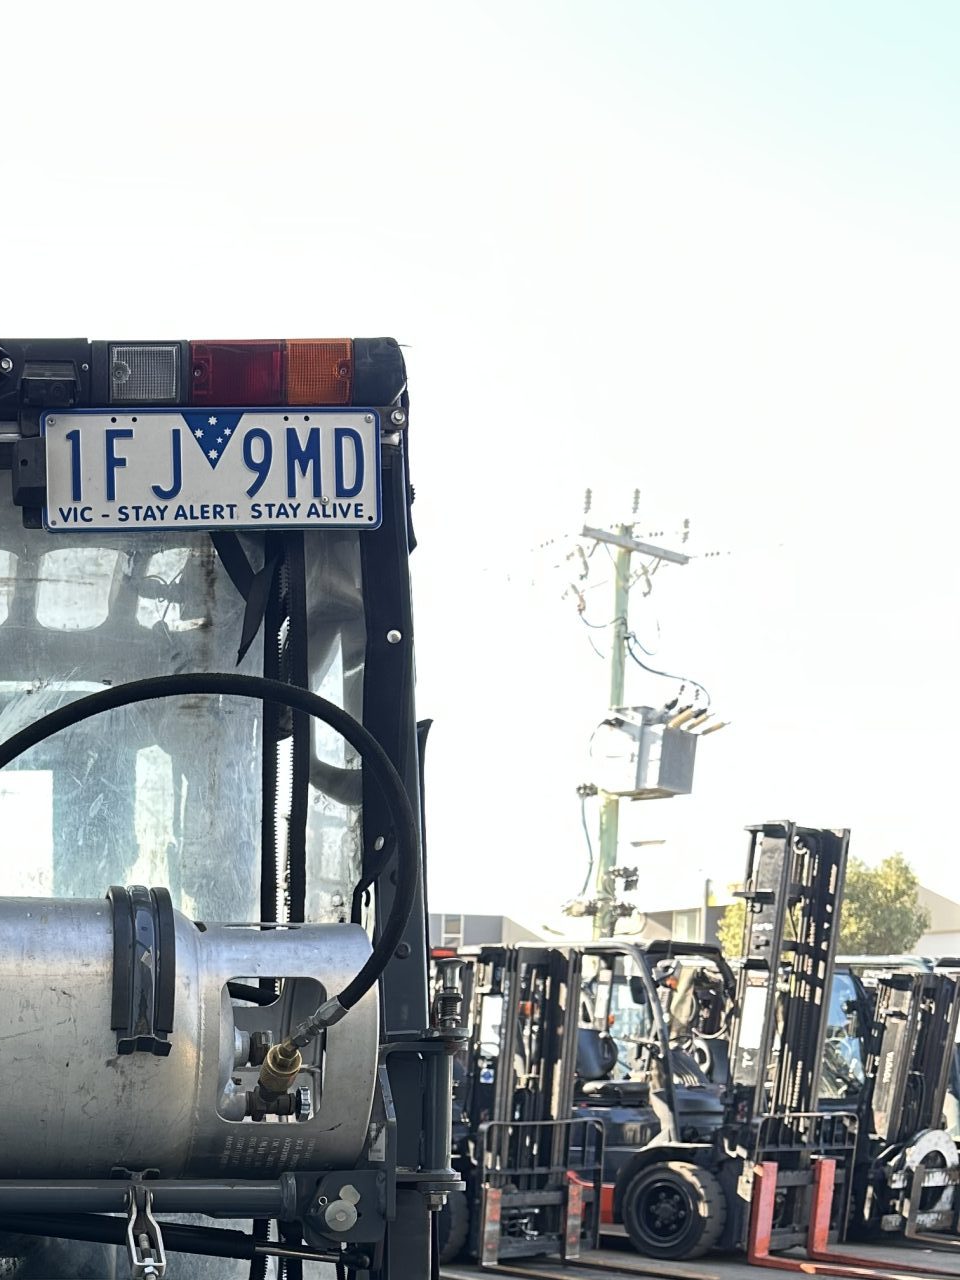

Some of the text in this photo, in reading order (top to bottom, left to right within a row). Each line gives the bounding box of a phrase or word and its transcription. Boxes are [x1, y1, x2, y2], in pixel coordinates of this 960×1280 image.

[58, 507, 92, 523] VIC
[118, 505, 168, 522] STAY
[174, 504, 237, 520] ALERT
[251, 503, 300, 519] STAY
[306, 503, 365, 519] ALIVE
